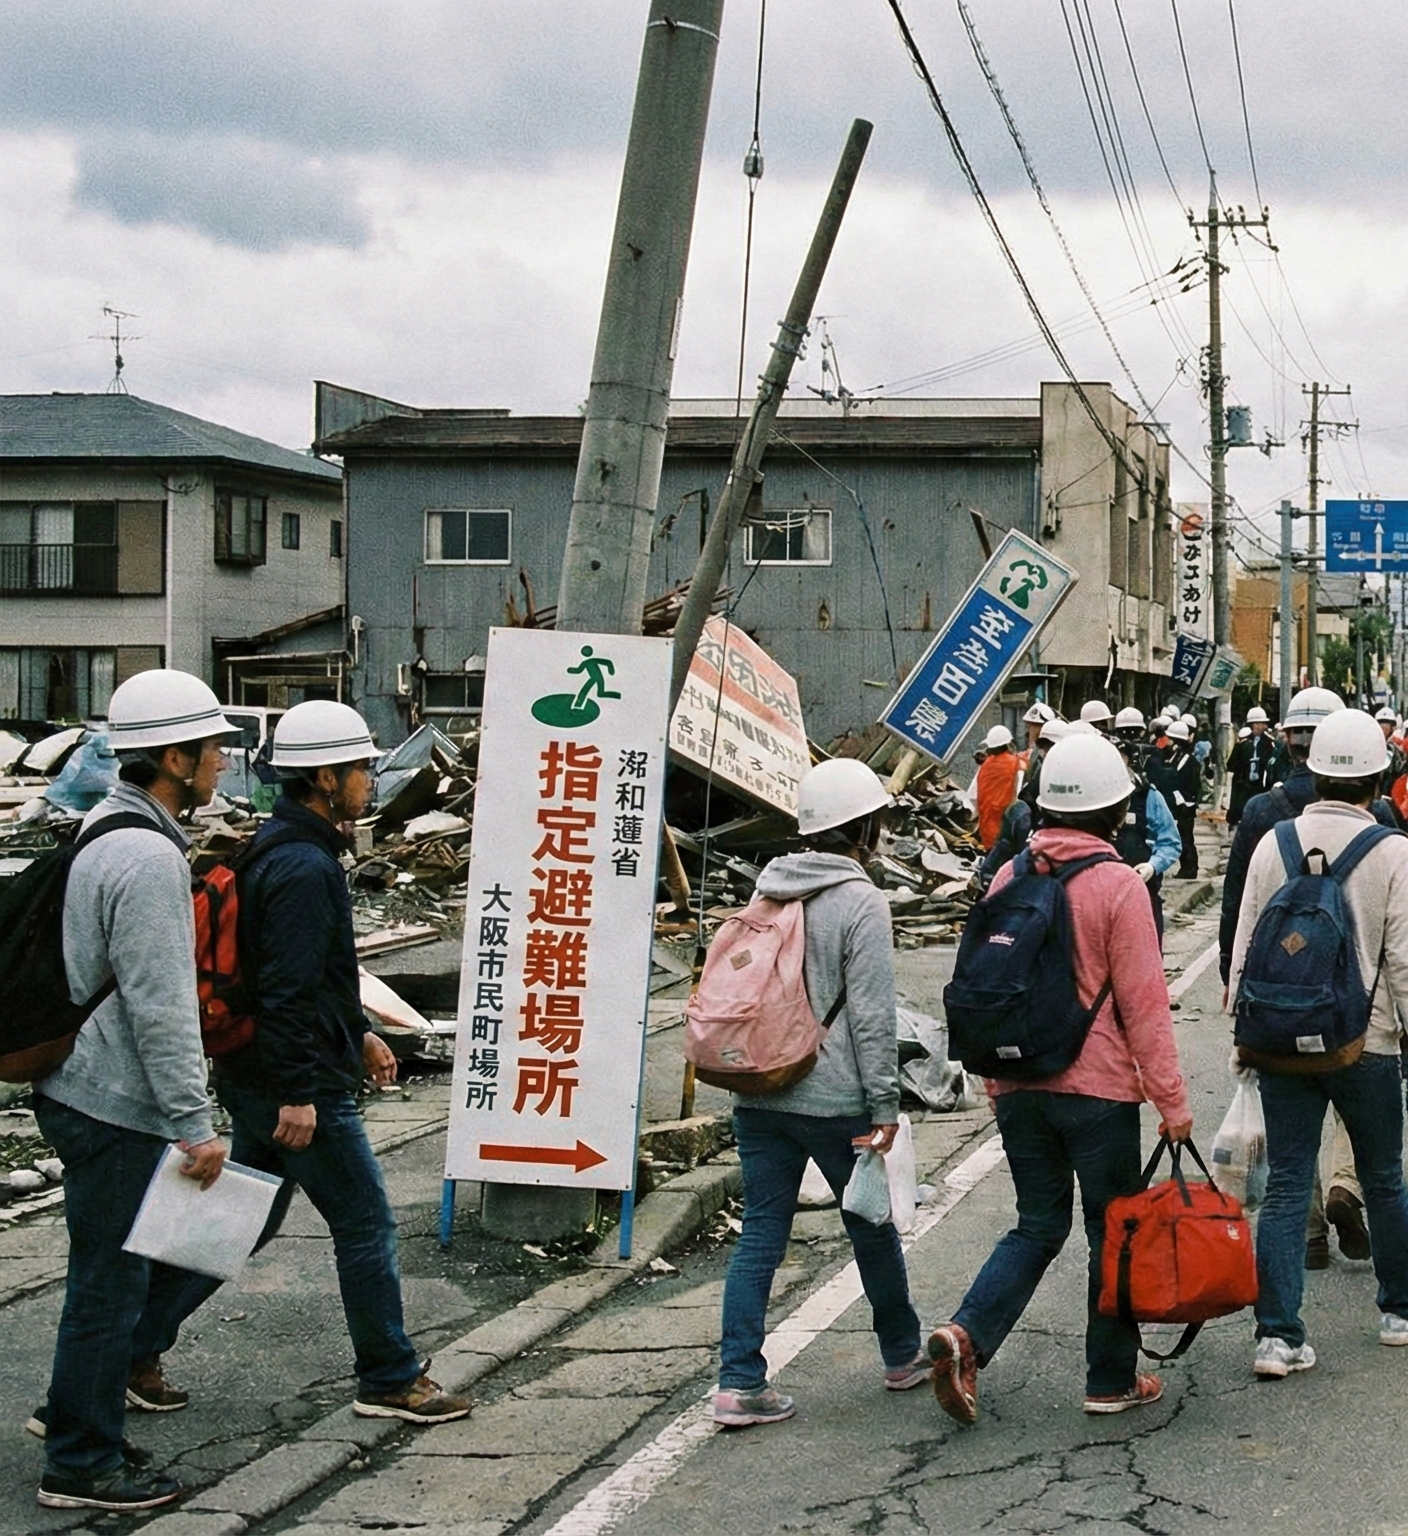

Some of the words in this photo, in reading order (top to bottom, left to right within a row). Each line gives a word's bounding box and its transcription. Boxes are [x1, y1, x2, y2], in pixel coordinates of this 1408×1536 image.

[466, 883, 512, 1111] 大阪市民町場所
[512, 741, 603, 1118] 指定避難場所
